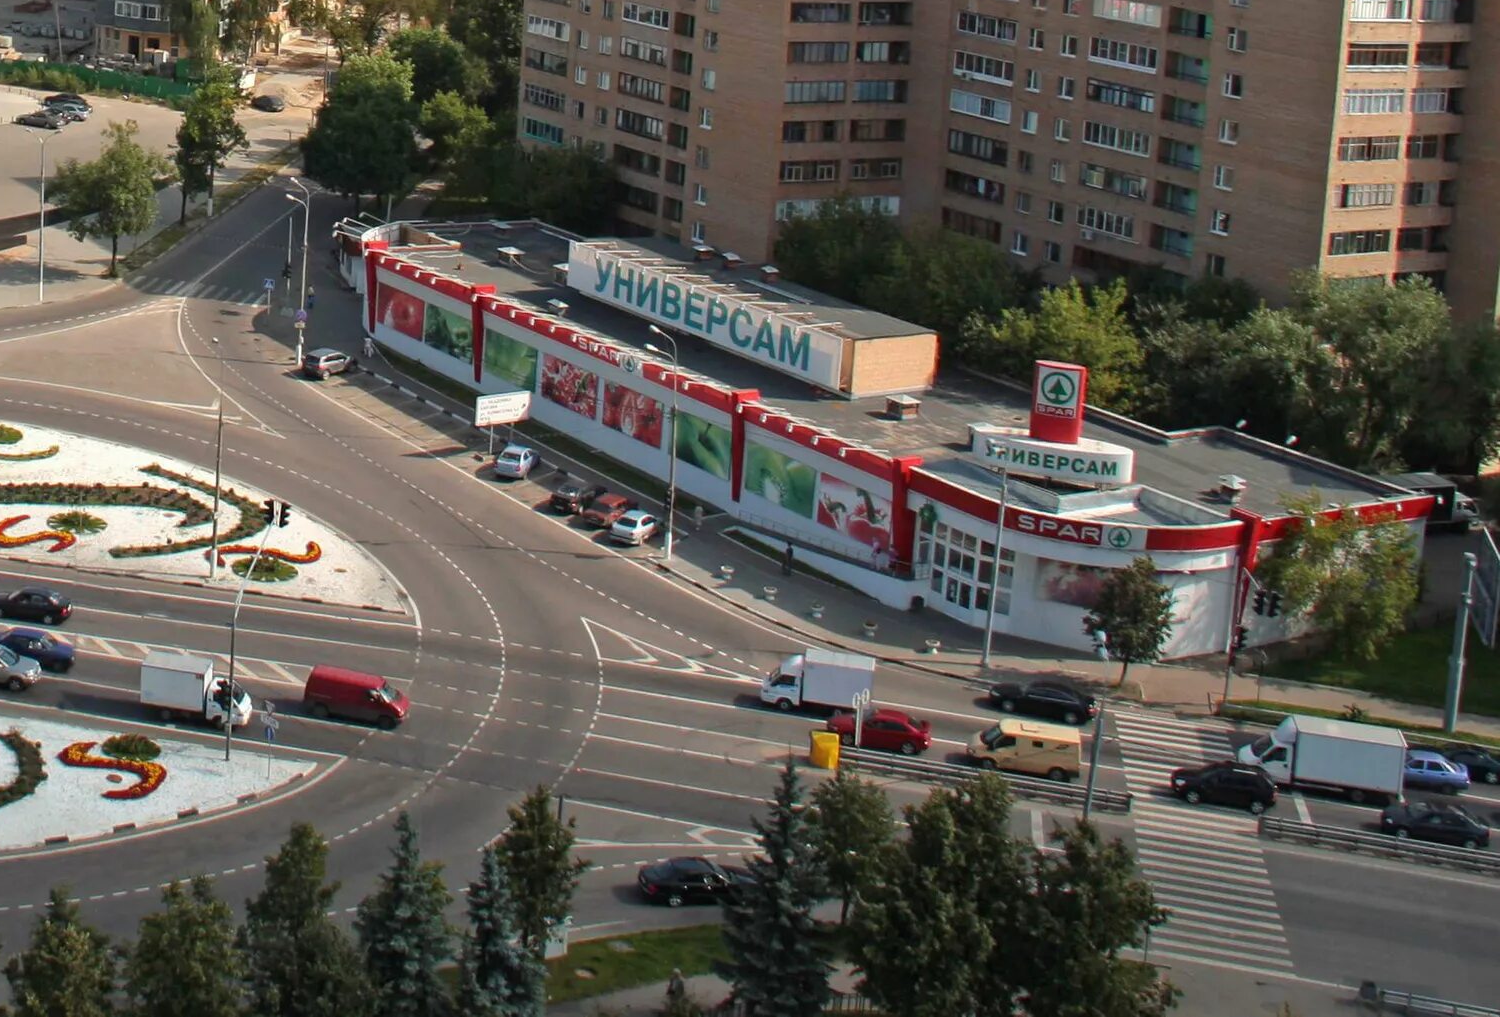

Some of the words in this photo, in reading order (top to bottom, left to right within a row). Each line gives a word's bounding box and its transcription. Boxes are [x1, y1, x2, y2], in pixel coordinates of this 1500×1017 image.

[593, 257, 811, 371] УНИВЕРСАМ
[1037, 404, 1075, 417] SPAR
[1017, 515, 1100, 542] SPAR
